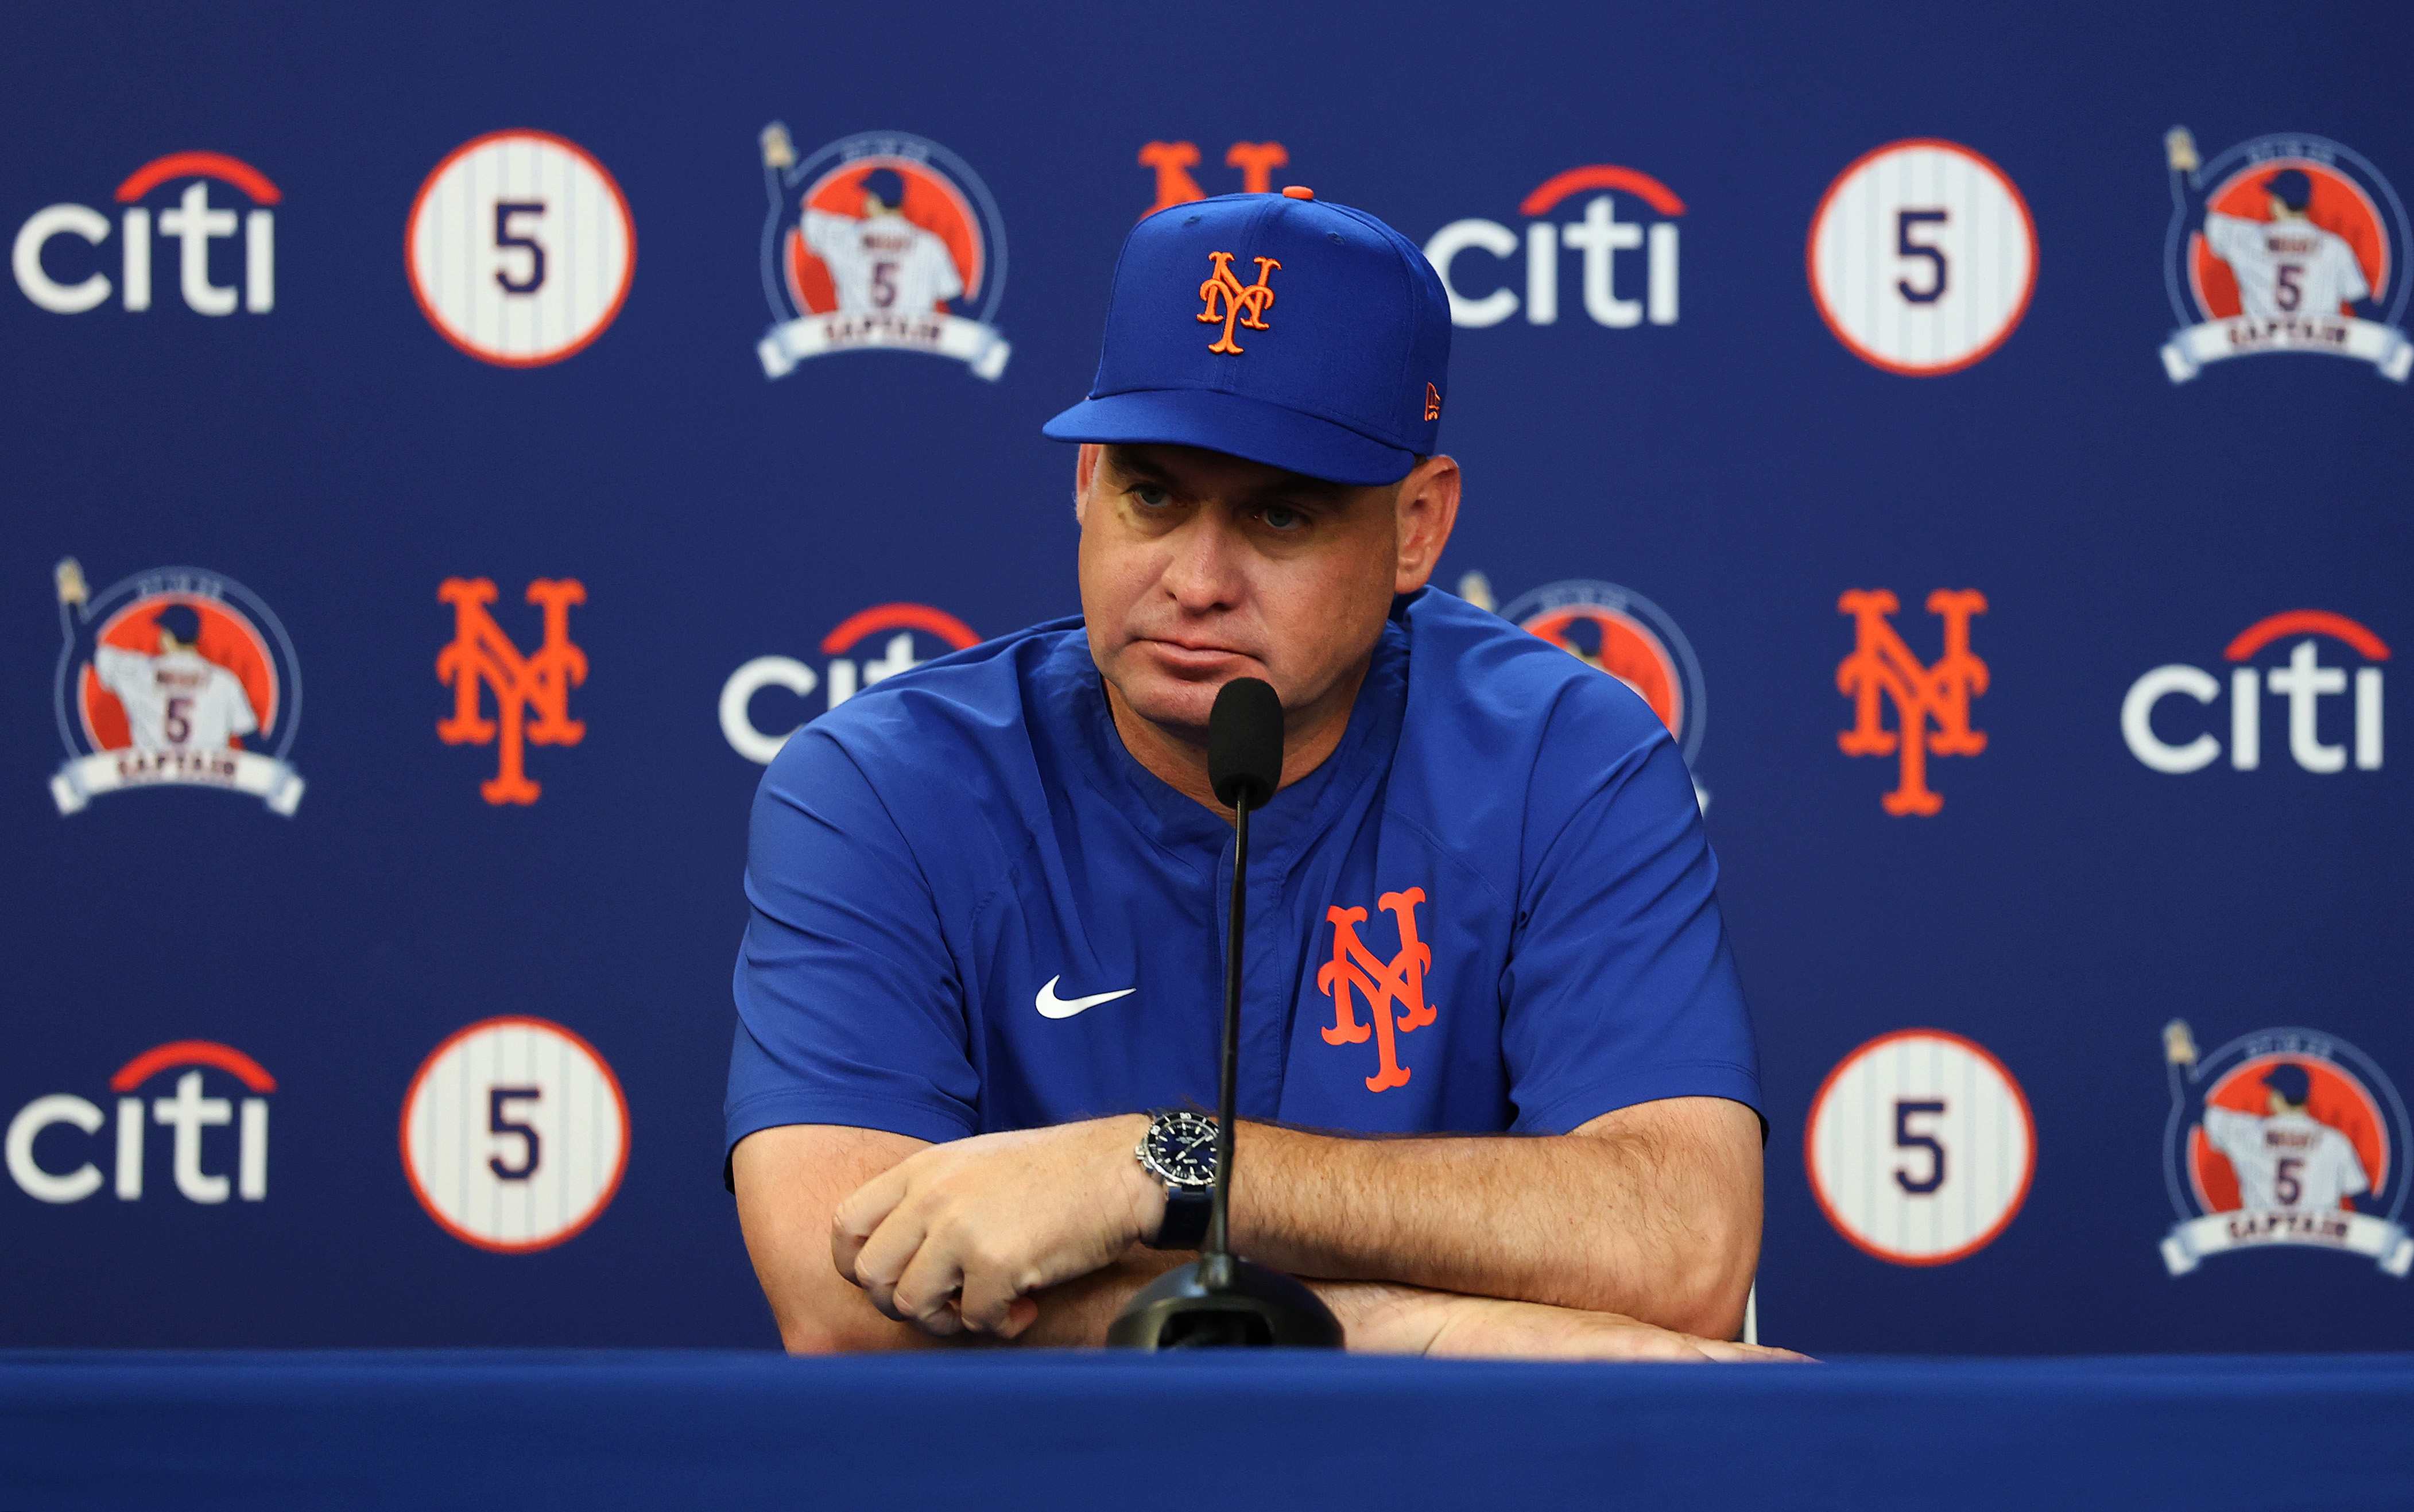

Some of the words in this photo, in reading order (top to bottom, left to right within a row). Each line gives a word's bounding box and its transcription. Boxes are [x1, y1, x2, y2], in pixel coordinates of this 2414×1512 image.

[11, 181, 276, 317] citi
[495, 201, 545, 296] 5
[871, 259, 898, 311] 5
[1422, 195, 1680, 329] citi
[1897, 209, 1948, 304] 5
[2275, 263, 2305, 312] 5
[1196, 250, 1282, 354] NY
[165, 697, 196, 745] 5
[2120, 641, 2385, 775] citi
[1316, 886, 1438, 1094] NY
[5, 1071, 269, 1204] citi
[489, 1087, 541, 1182] 5
[1895, 1099, 1946, 1195] 5
[2274, 1155, 2305, 1205] 5
